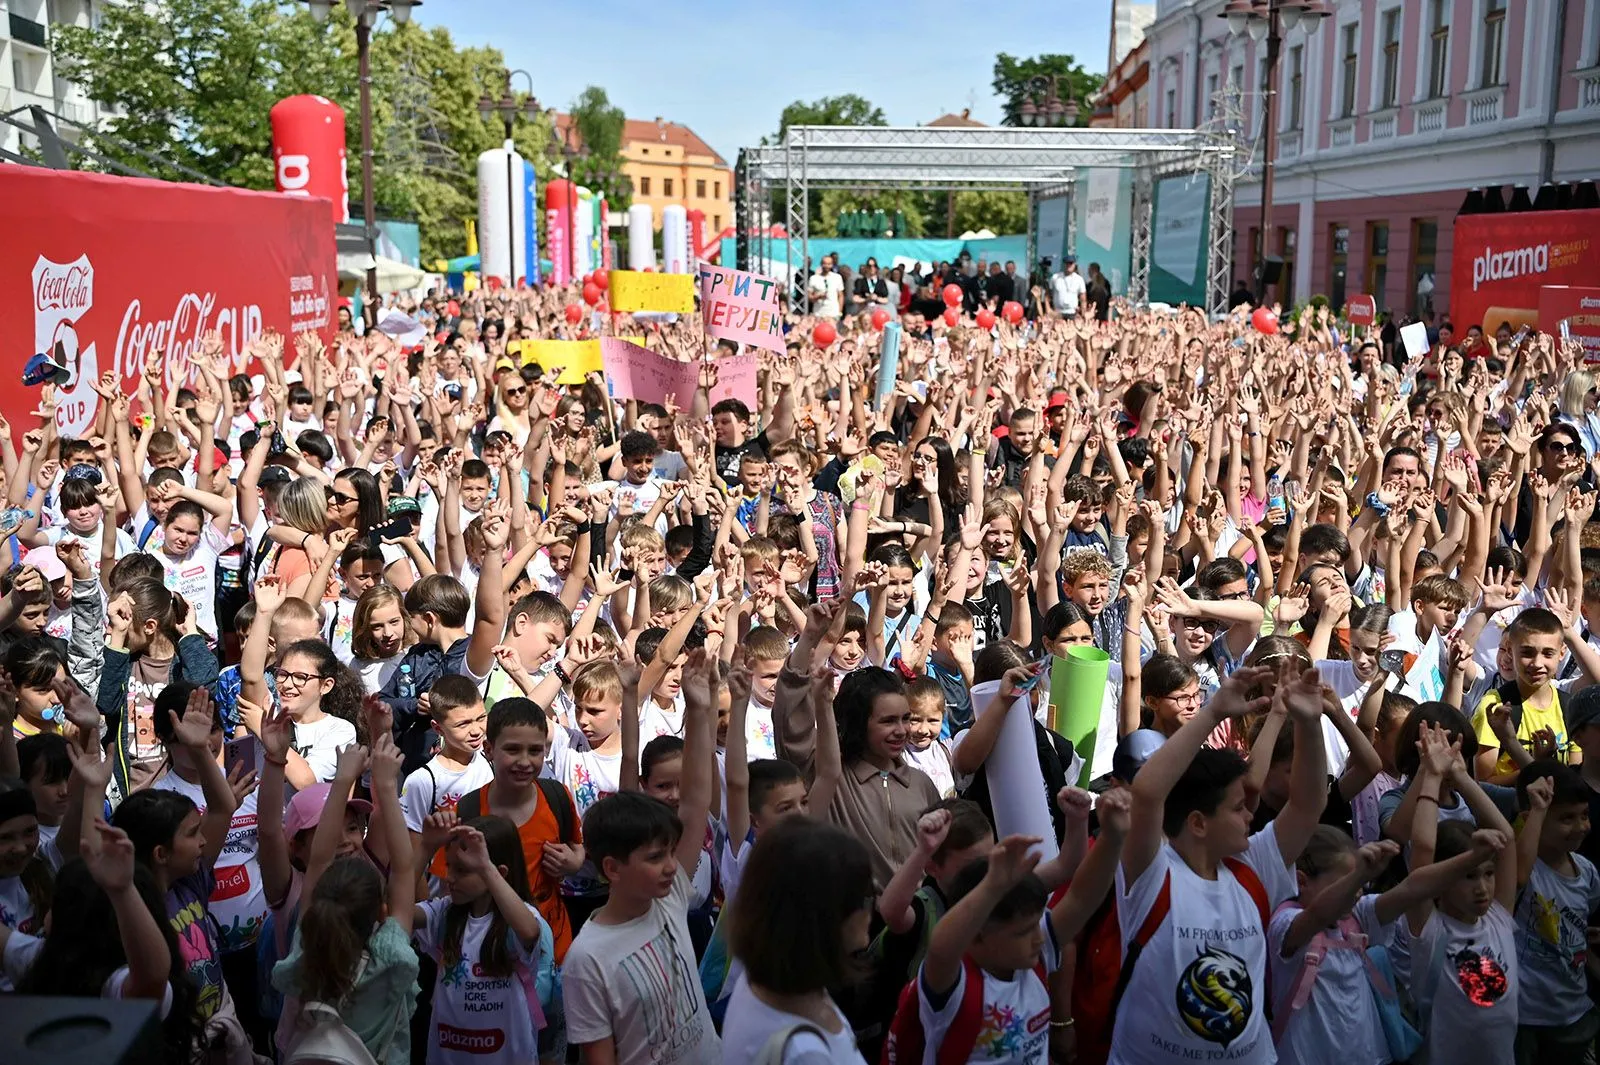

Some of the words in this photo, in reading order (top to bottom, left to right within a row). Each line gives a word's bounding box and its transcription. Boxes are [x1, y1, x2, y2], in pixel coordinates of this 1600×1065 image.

[1473, 243, 1549, 291] plazma
[37, 266, 90, 311] Coca-Cola
[215, 304, 263, 369] CUP
[56, 401, 85, 427] CUP
[464, 992, 487, 1001] IGRE
[464, 1001, 503, 1012] MLADIH
[439, 1029, 495, 1048] plazma
[1151, 1033, 1180, 1054] TAKE
[1183, 1047, 1201, 1060] ME
[1207, 1049, 1225, 1060] TO
